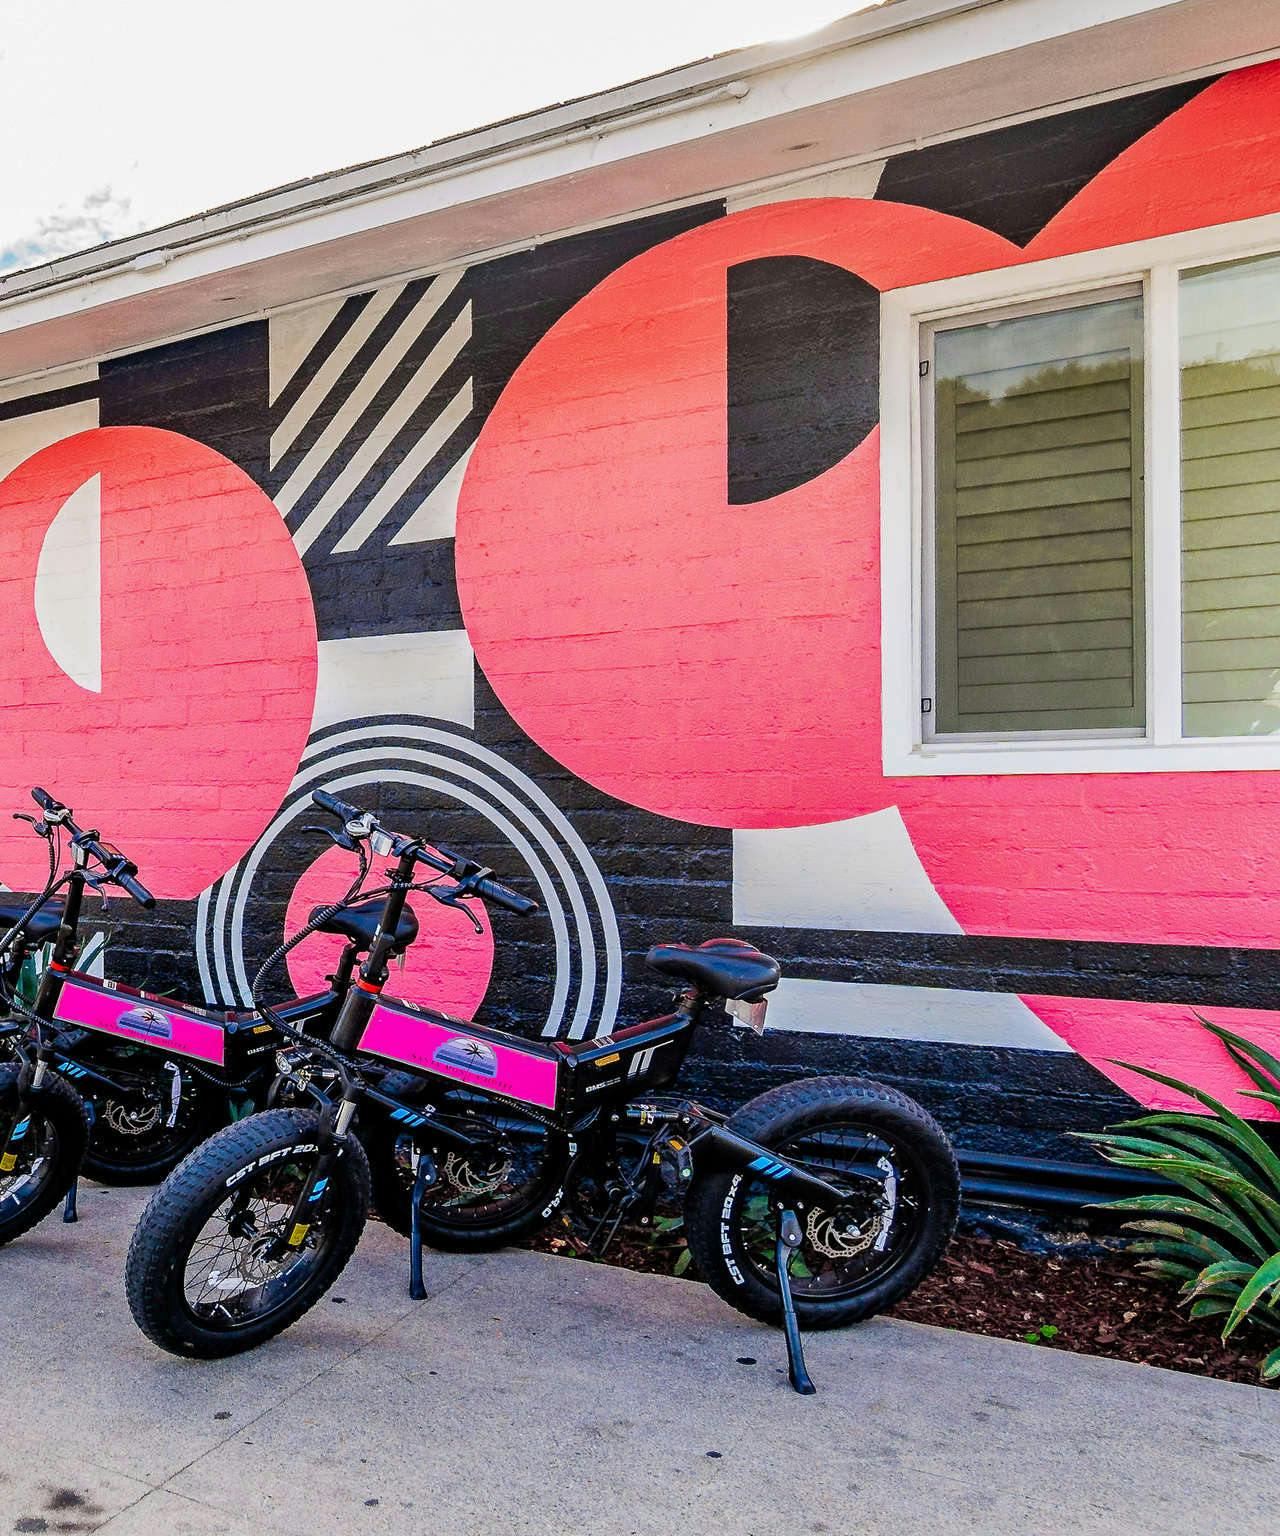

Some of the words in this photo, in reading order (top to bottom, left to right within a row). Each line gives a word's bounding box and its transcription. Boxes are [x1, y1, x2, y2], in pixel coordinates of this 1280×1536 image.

[225, 1161, 256, 1187] CST
[258, 1146, 292, 1167] BFT
[541, 1187, 564, 1218] x4.0
[721, 1174, 744, 1219] 20x4.
[720, 1222, 733, 1255] BFT
[724, 1258, 745, 1285] CST
